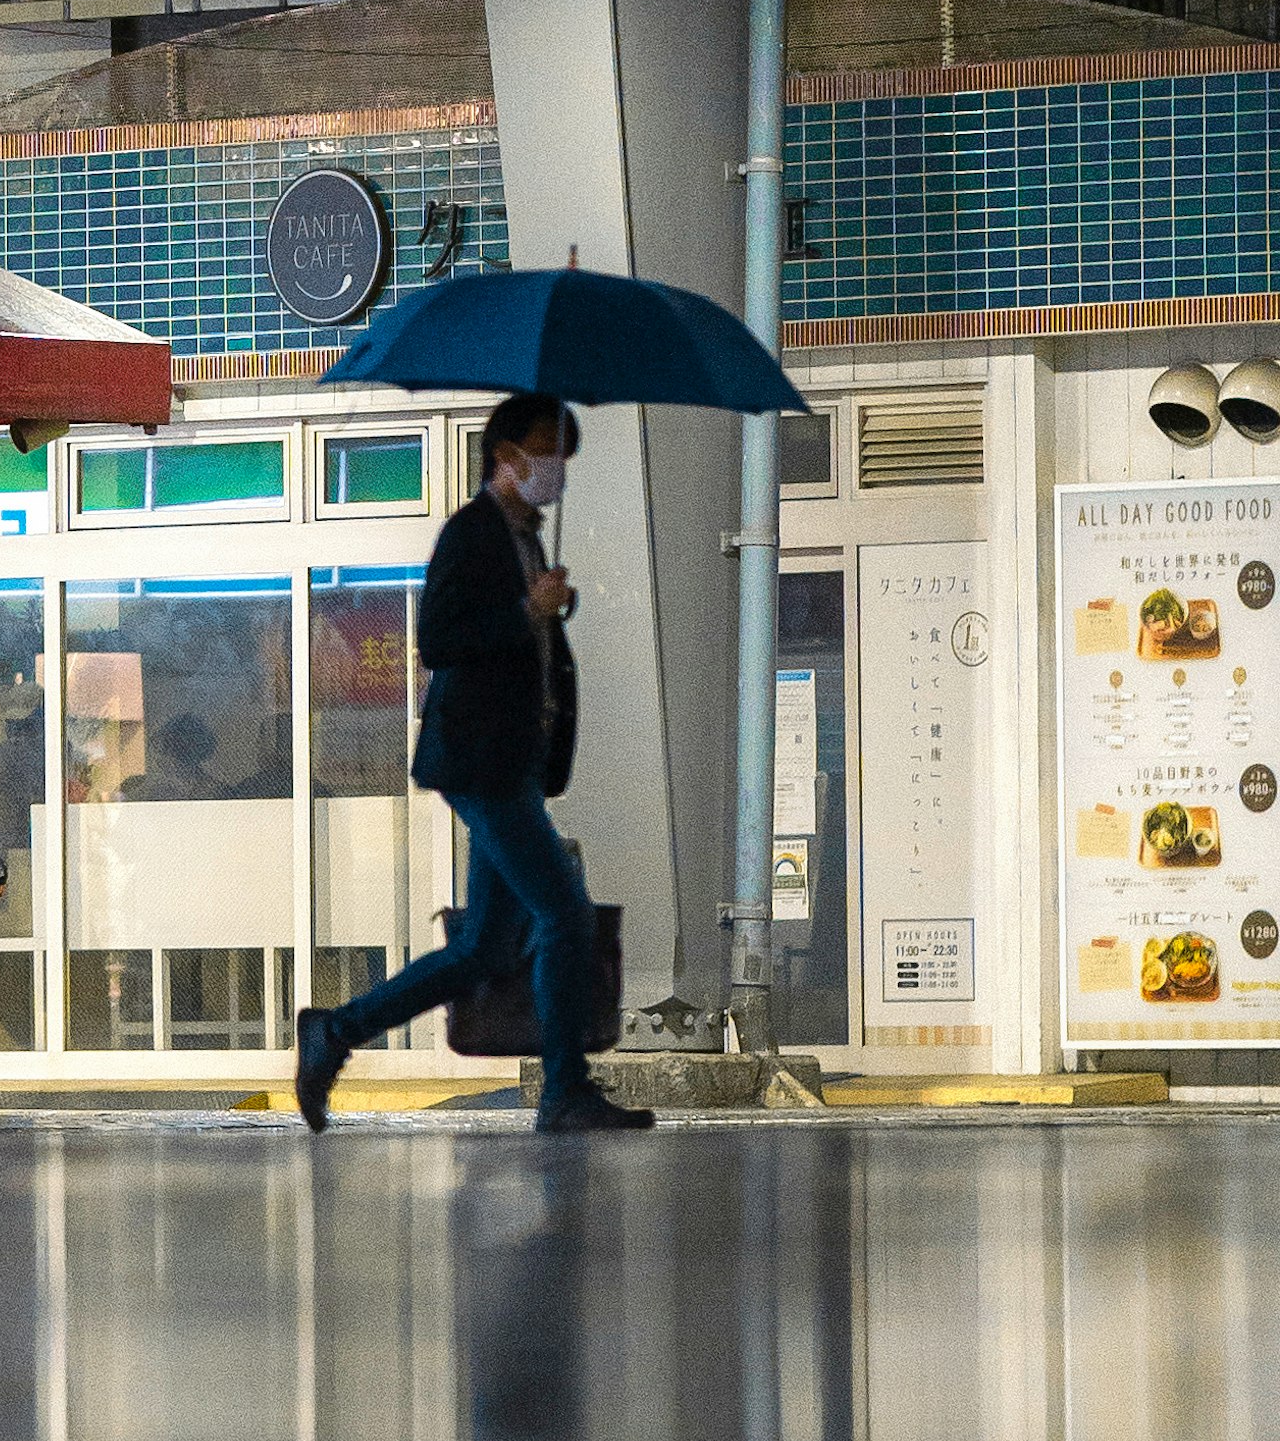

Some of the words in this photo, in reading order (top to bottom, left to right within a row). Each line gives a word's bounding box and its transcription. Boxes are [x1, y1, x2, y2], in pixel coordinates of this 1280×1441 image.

[284, 213, 363, 239] TANITA
[293, 243, 354, 269] CAFE
[1077, 505, 1109, 527] ALL
[1120, 503, 1153, 526] DAY
[1165, 500, 1213, 524] GOOD
[1225, 498, 1272, 521] FOOD
[879, 576, 972, 596] タニタカフェ
[896, 931, 921, 941] OPEN
[927, 930, 958, 941] HOURS
